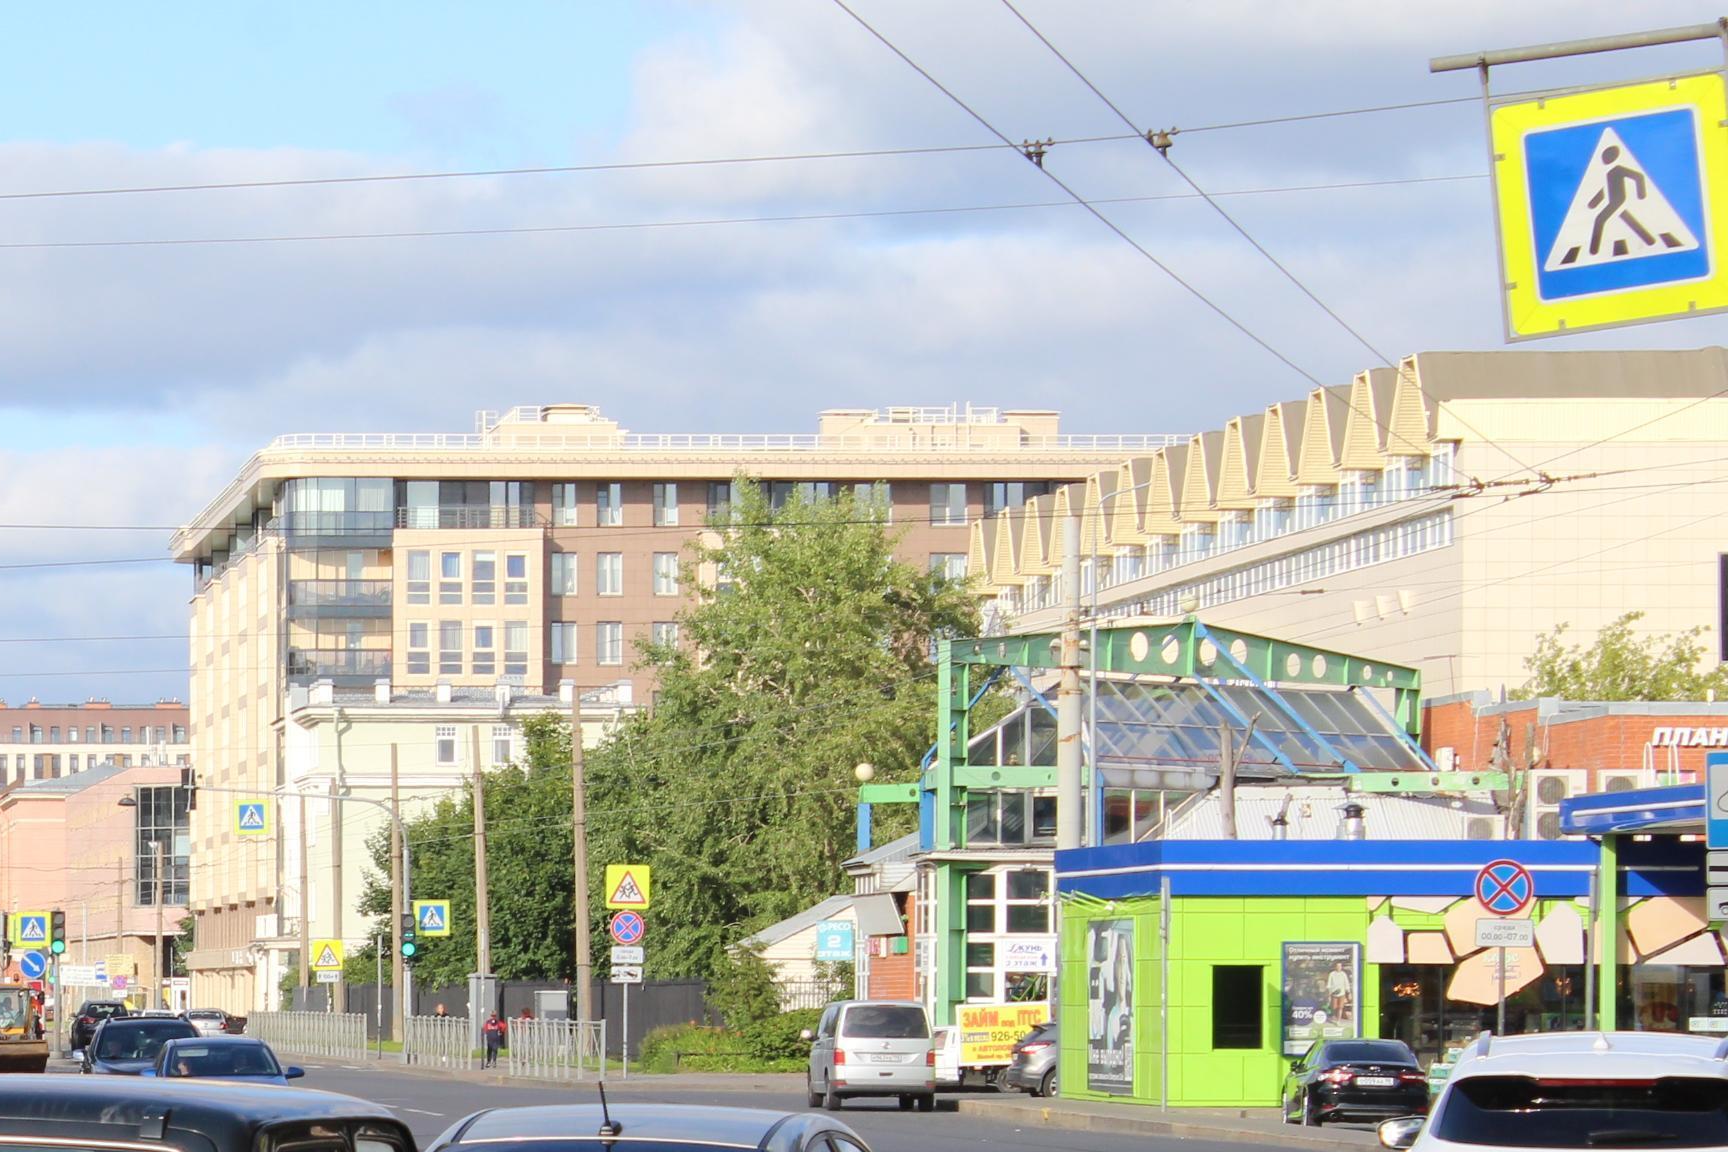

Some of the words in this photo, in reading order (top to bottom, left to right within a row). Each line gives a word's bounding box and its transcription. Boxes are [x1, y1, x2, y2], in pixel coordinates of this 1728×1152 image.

[827, 934, 842, 948] 2
[963, 1008, 999, 1028] ЗАЙМ
[1292, 1010, 1313, 1019] 40%
